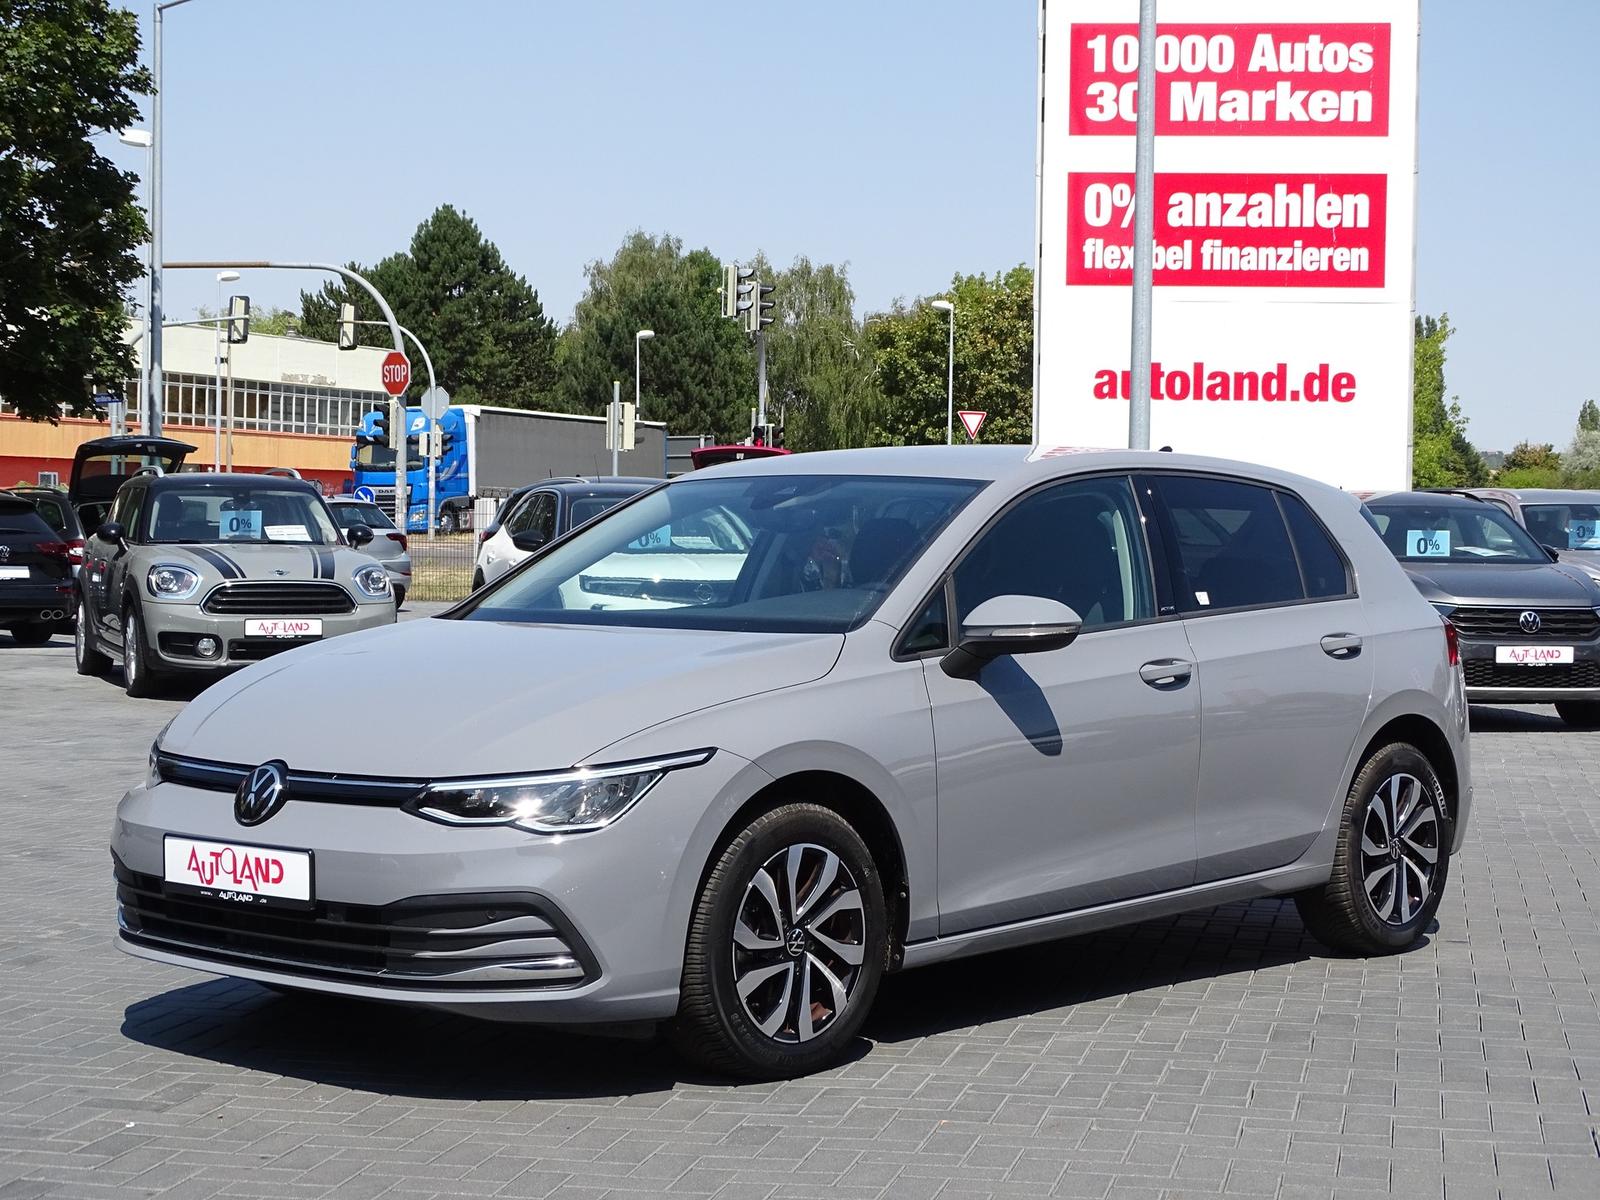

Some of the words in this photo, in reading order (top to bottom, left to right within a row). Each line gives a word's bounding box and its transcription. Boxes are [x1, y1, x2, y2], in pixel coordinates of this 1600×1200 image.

[1247, 34, 1374, 73] Autos
[1169, 81, 1372, 122] Marken
[1167, 183, 1370, 228] anzahlen
[1083, 239, 1192, 271] flexbel
[1201, 240, 1369, 272] finanzieren
[383, 365, 407, 383] STOP
[229, 517, 252, 533] 0%
[1576, 525, 1595, 538] 0%
[1416, 537, 1440, 555] 0%
[187, 844, 284, 891] AUTOLAND
[218, 890, 254, 903] AUTOLAND
